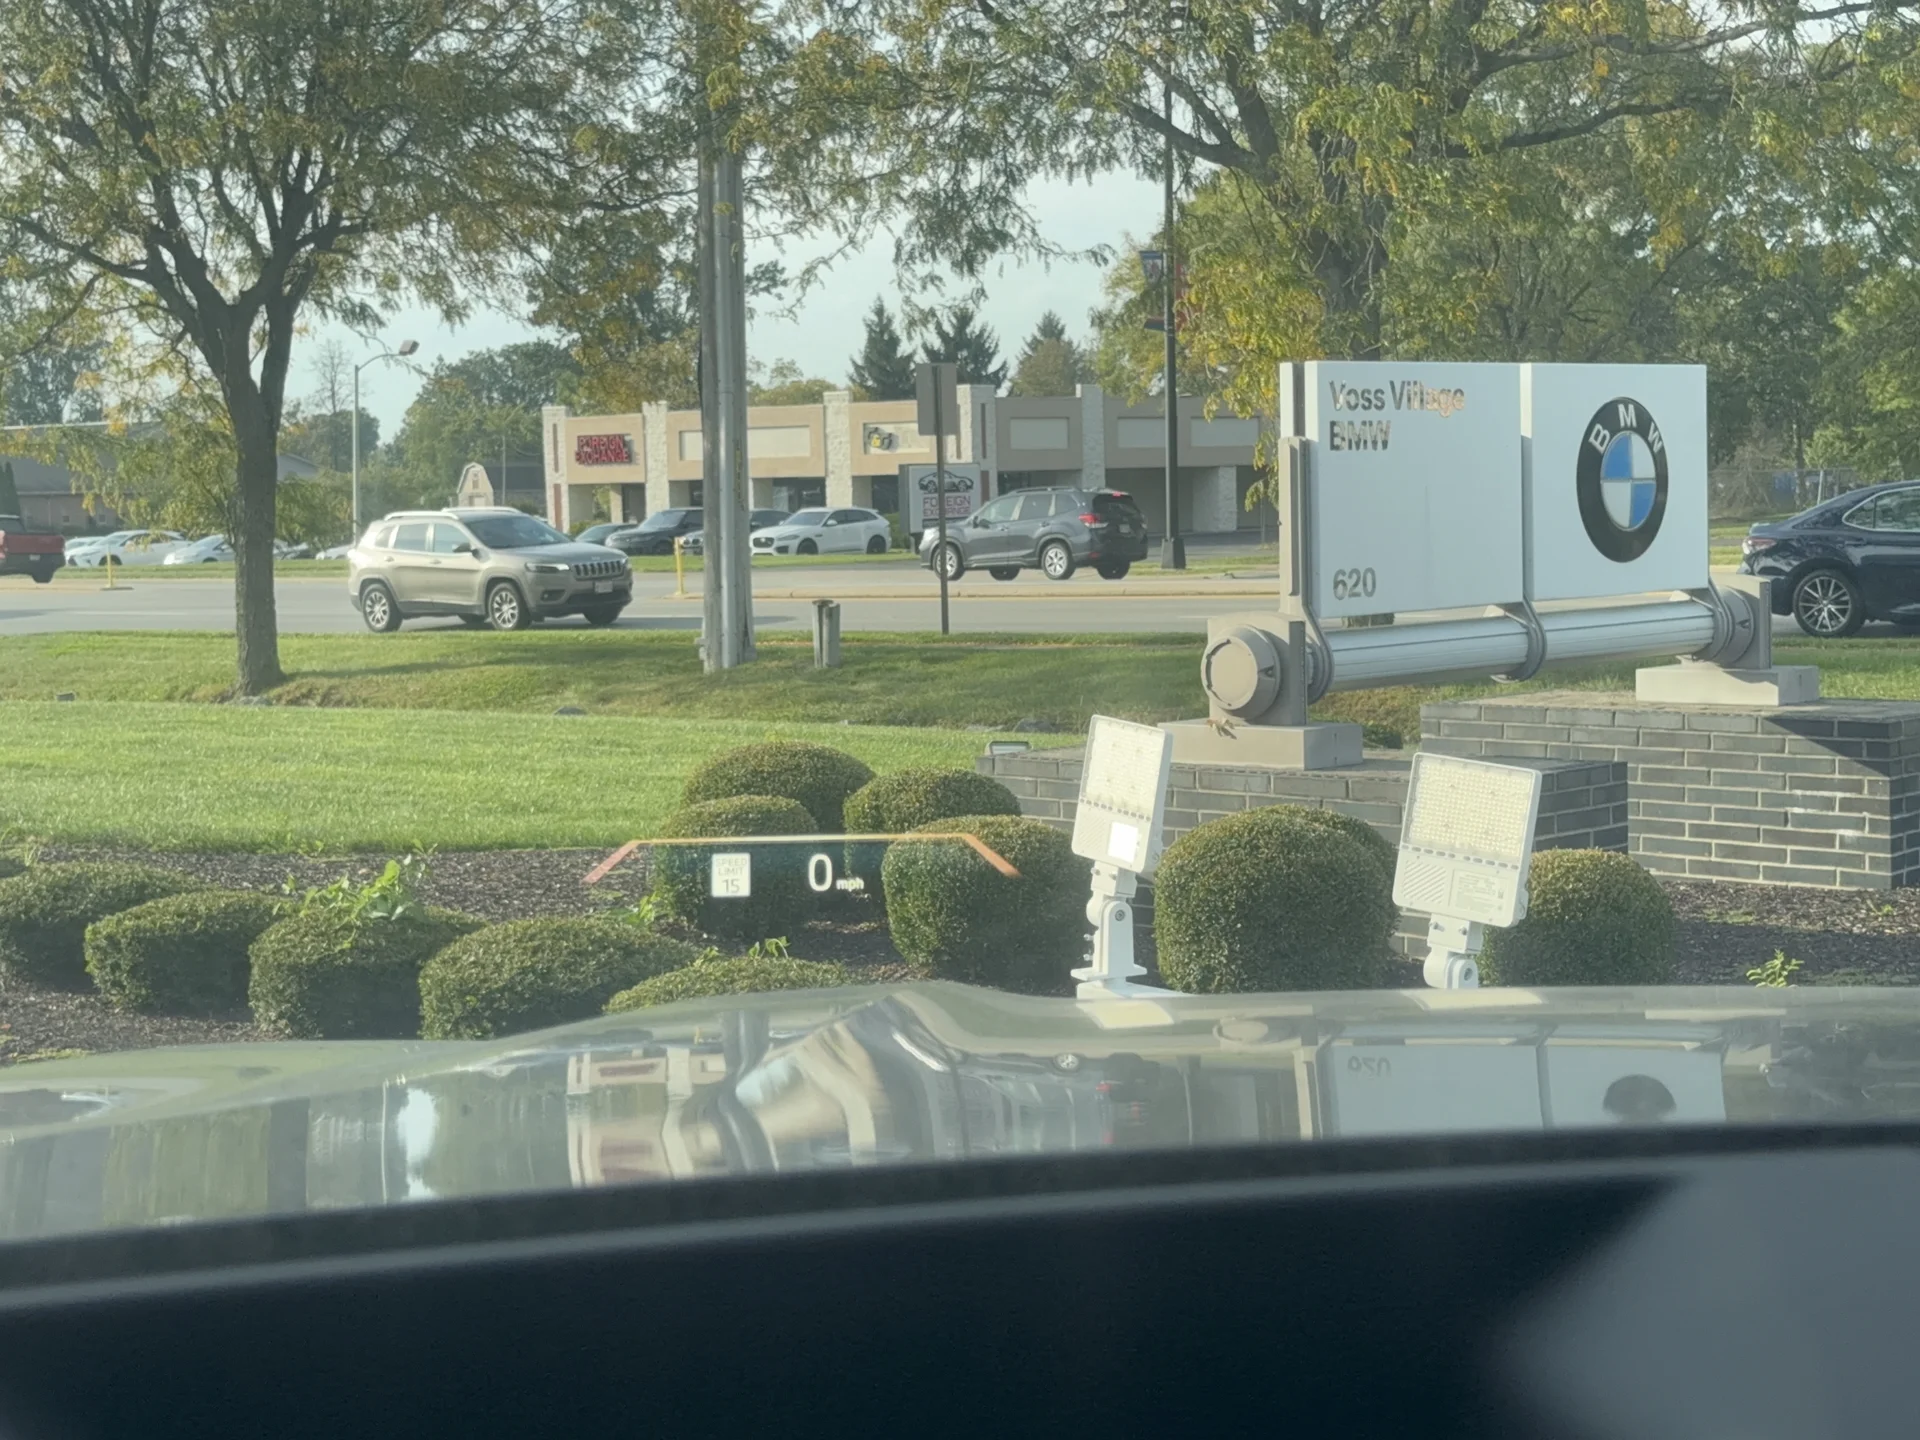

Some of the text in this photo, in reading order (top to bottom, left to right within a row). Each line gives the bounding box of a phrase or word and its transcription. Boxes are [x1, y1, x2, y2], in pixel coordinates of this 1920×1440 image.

[1329, 380, 1465, 418] Voss Village
[1329, 420, 1391, 451] BMW
[1588, 404, 1663, 454] BMW
[923, 495, 971, 508] FOEIGN
[1333, 567, 1376, 601] 620
[715, 857, 747, 867] SPEED
[718, 866, 744, 877] LIMIT
[808, 853, 864, 892] 0 mph
[721, 878, 741, 894] 15
